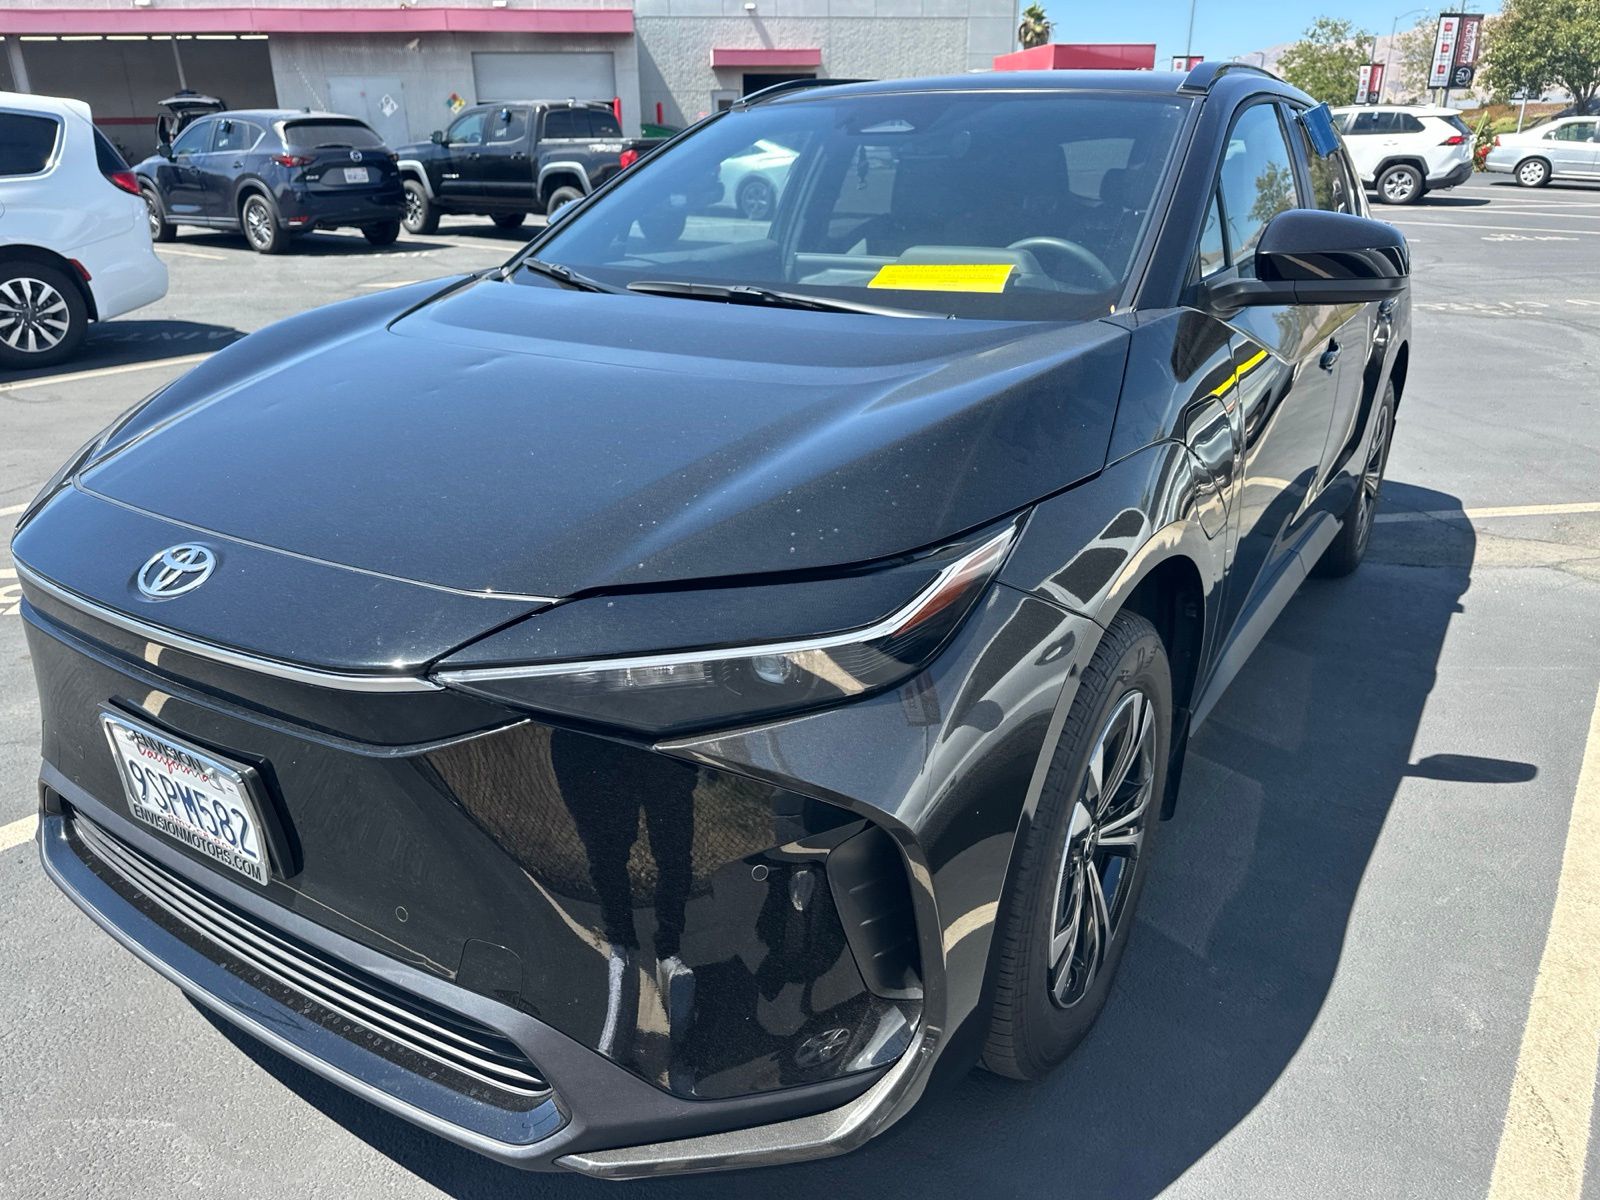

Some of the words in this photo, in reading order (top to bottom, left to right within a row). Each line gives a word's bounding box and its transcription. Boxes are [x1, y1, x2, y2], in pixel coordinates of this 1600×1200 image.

[1461, 21, 1474, 63] ENVISION
[132, 730, 204, 773] ENVISION
[128, 759, 257, 859] 9SPM582
[133, 804, 262, 881] ENVISIONMOTORS.COM
